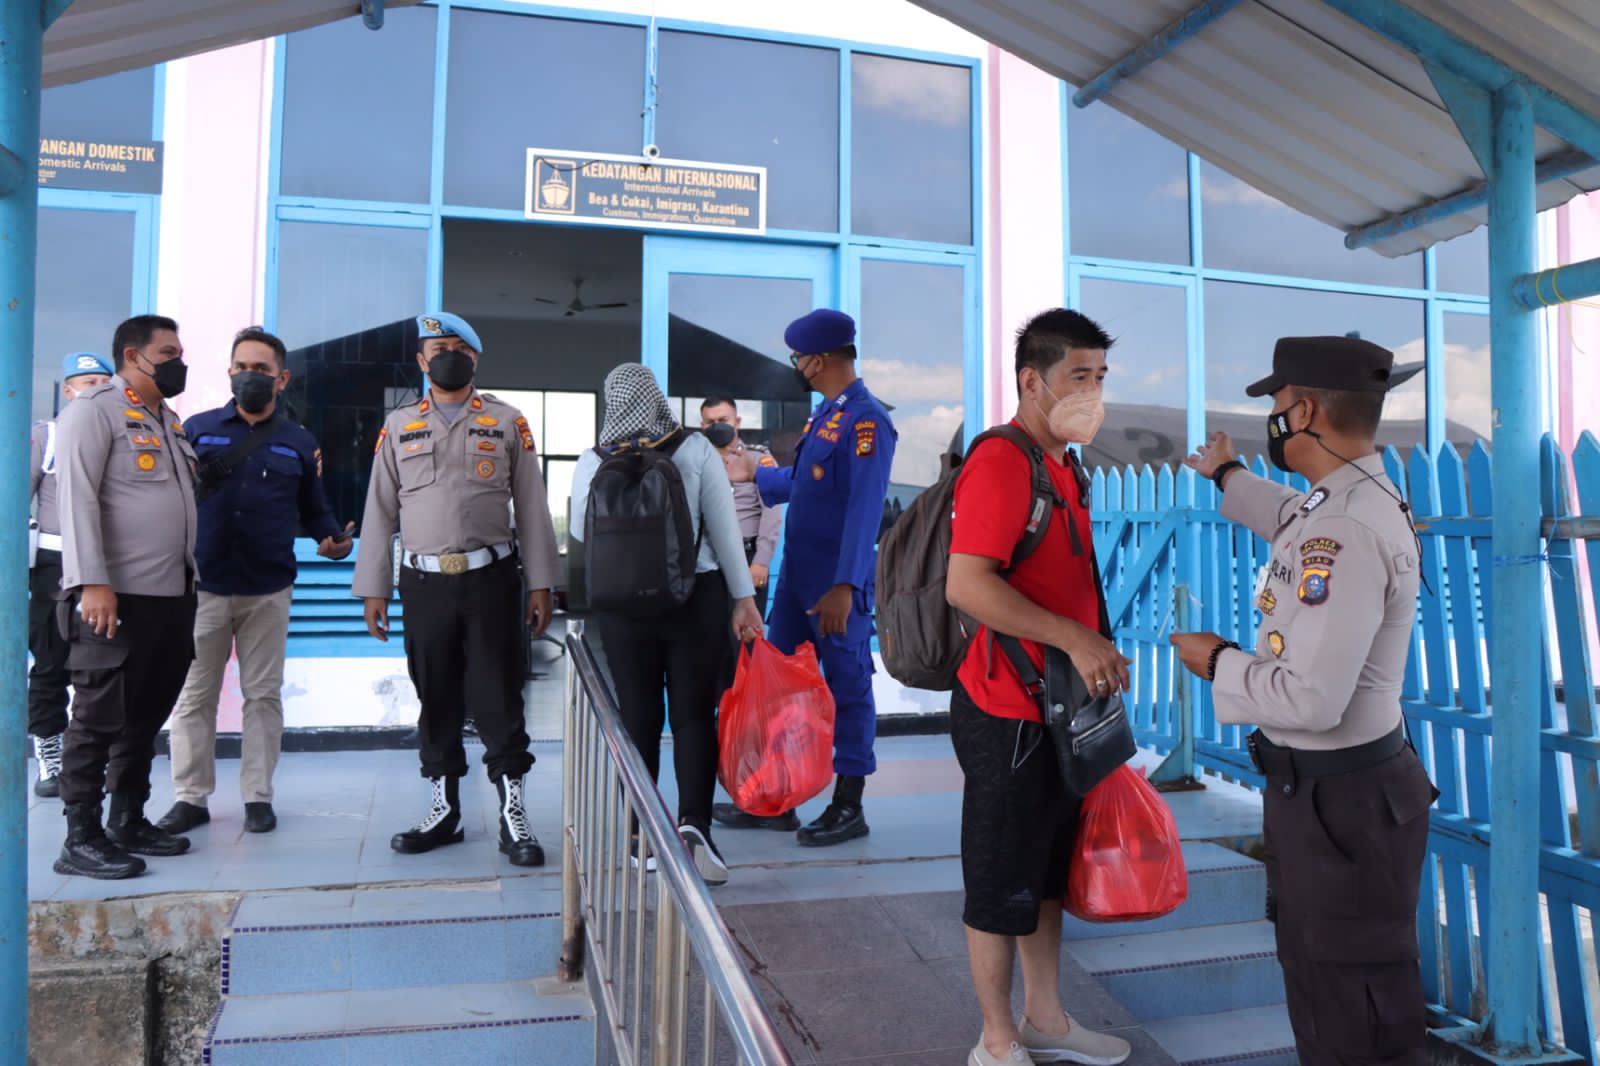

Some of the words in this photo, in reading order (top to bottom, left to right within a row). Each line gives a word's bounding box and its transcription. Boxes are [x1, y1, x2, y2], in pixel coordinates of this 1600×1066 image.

[40, 139, 86, 157] ANGAN
[88, 143, 156, 162] DOMESTIK
[83, 159, 127, 173] Arrivals
[582, 162, 661, 183] KEDATANGAN
[665, 169, 757, 191] INTERNASIONAL
[624, 182, 681, 196] International
[681, 186, 717, 198] Arrivals
[588, 192, 609, 205] Bea
[610, 194, 619, 206] &
[621, 195, 654, 210] Cukai,
[656, 197, 700, 214] Imigrasi,
[703, 201, 750, 217] Karantina
[692, 215, 736, 226] Quarantine
[468, 427, 504, 439] POLRI
